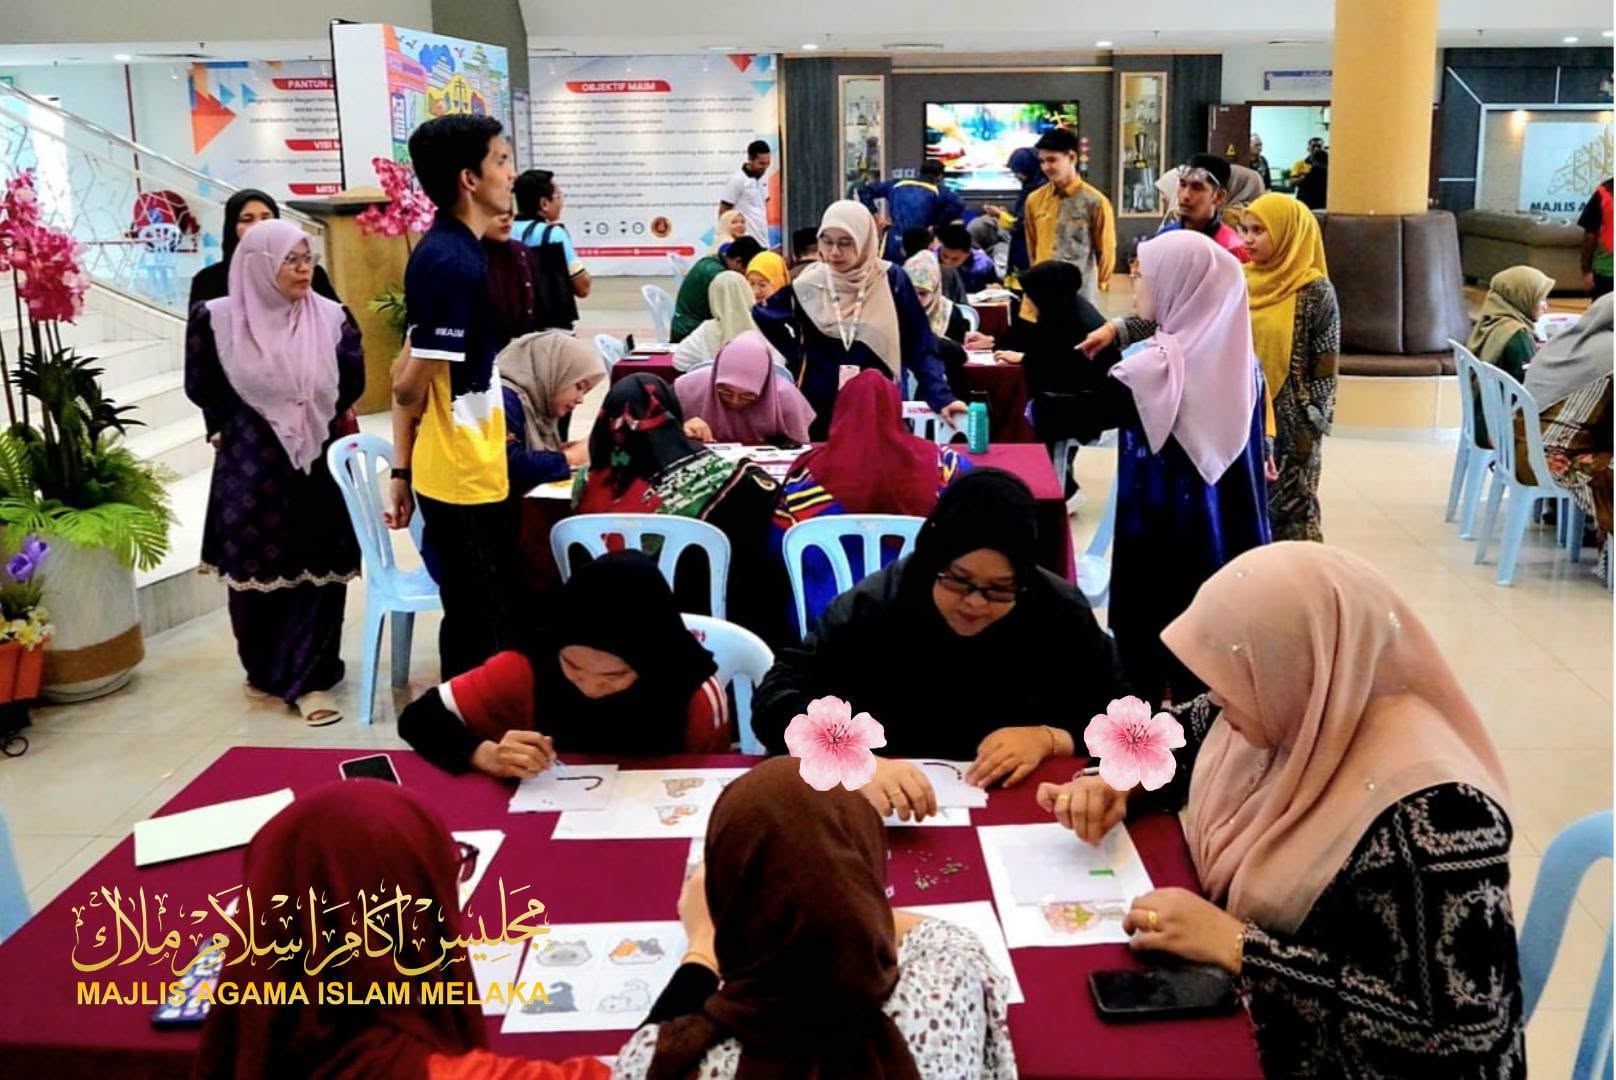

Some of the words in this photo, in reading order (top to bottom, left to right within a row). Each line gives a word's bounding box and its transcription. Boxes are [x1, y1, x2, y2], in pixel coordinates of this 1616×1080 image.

[287, 80, 327, 89] PANTUN
[582, 82, 624, 91] OBJEKTIF
[627, 81, 655, 90] MAIM
[1530, 202, 1575, 212] MAJLIS
